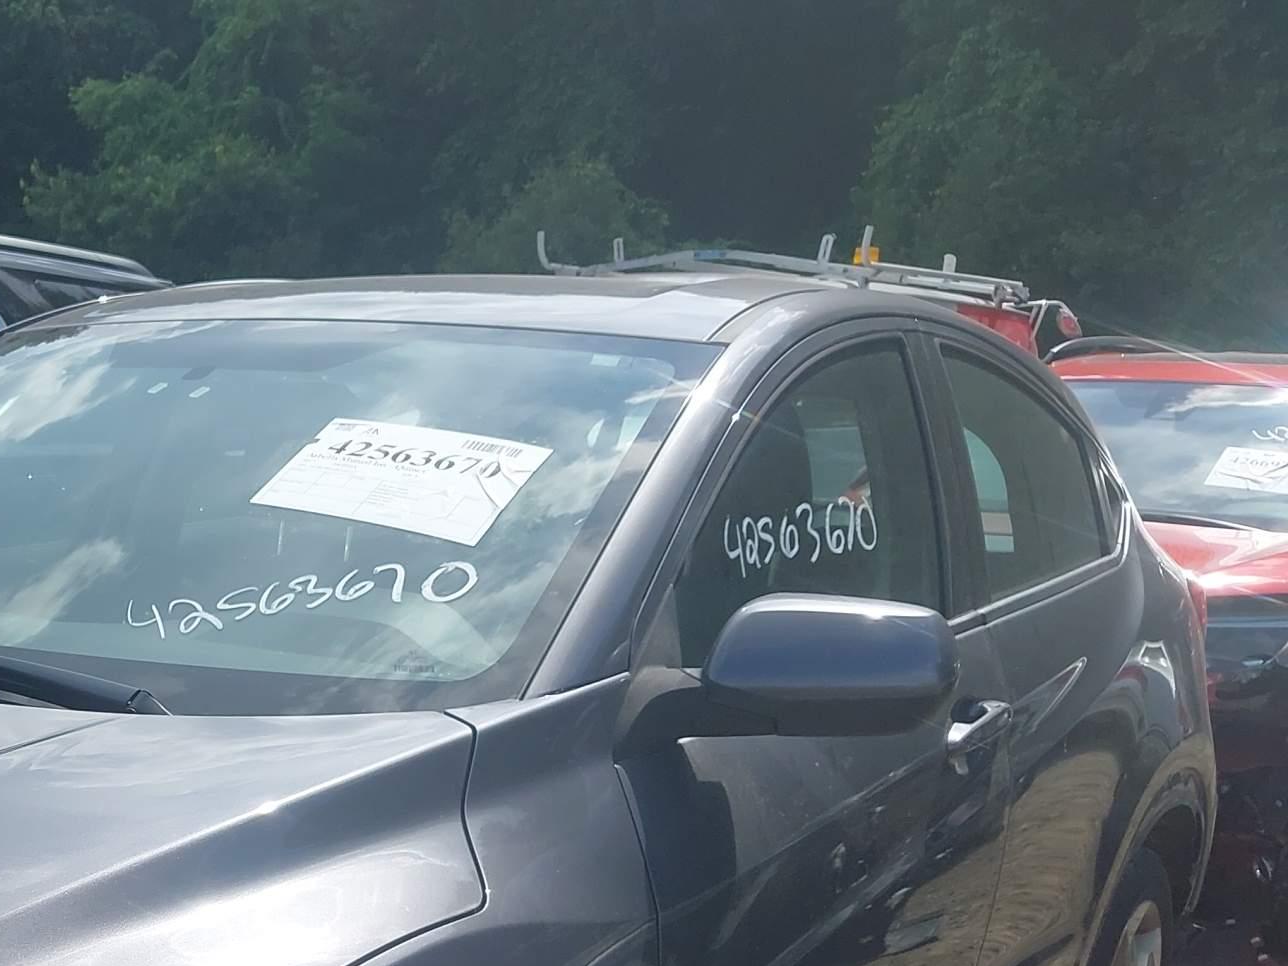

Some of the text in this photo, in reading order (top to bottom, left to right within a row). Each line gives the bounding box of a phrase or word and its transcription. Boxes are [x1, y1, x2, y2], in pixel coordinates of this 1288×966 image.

[328, 439, 502, 479] 42563670
[724, 495, 877, 578] 42563670
[127, 561, 478, 639] 42563670
